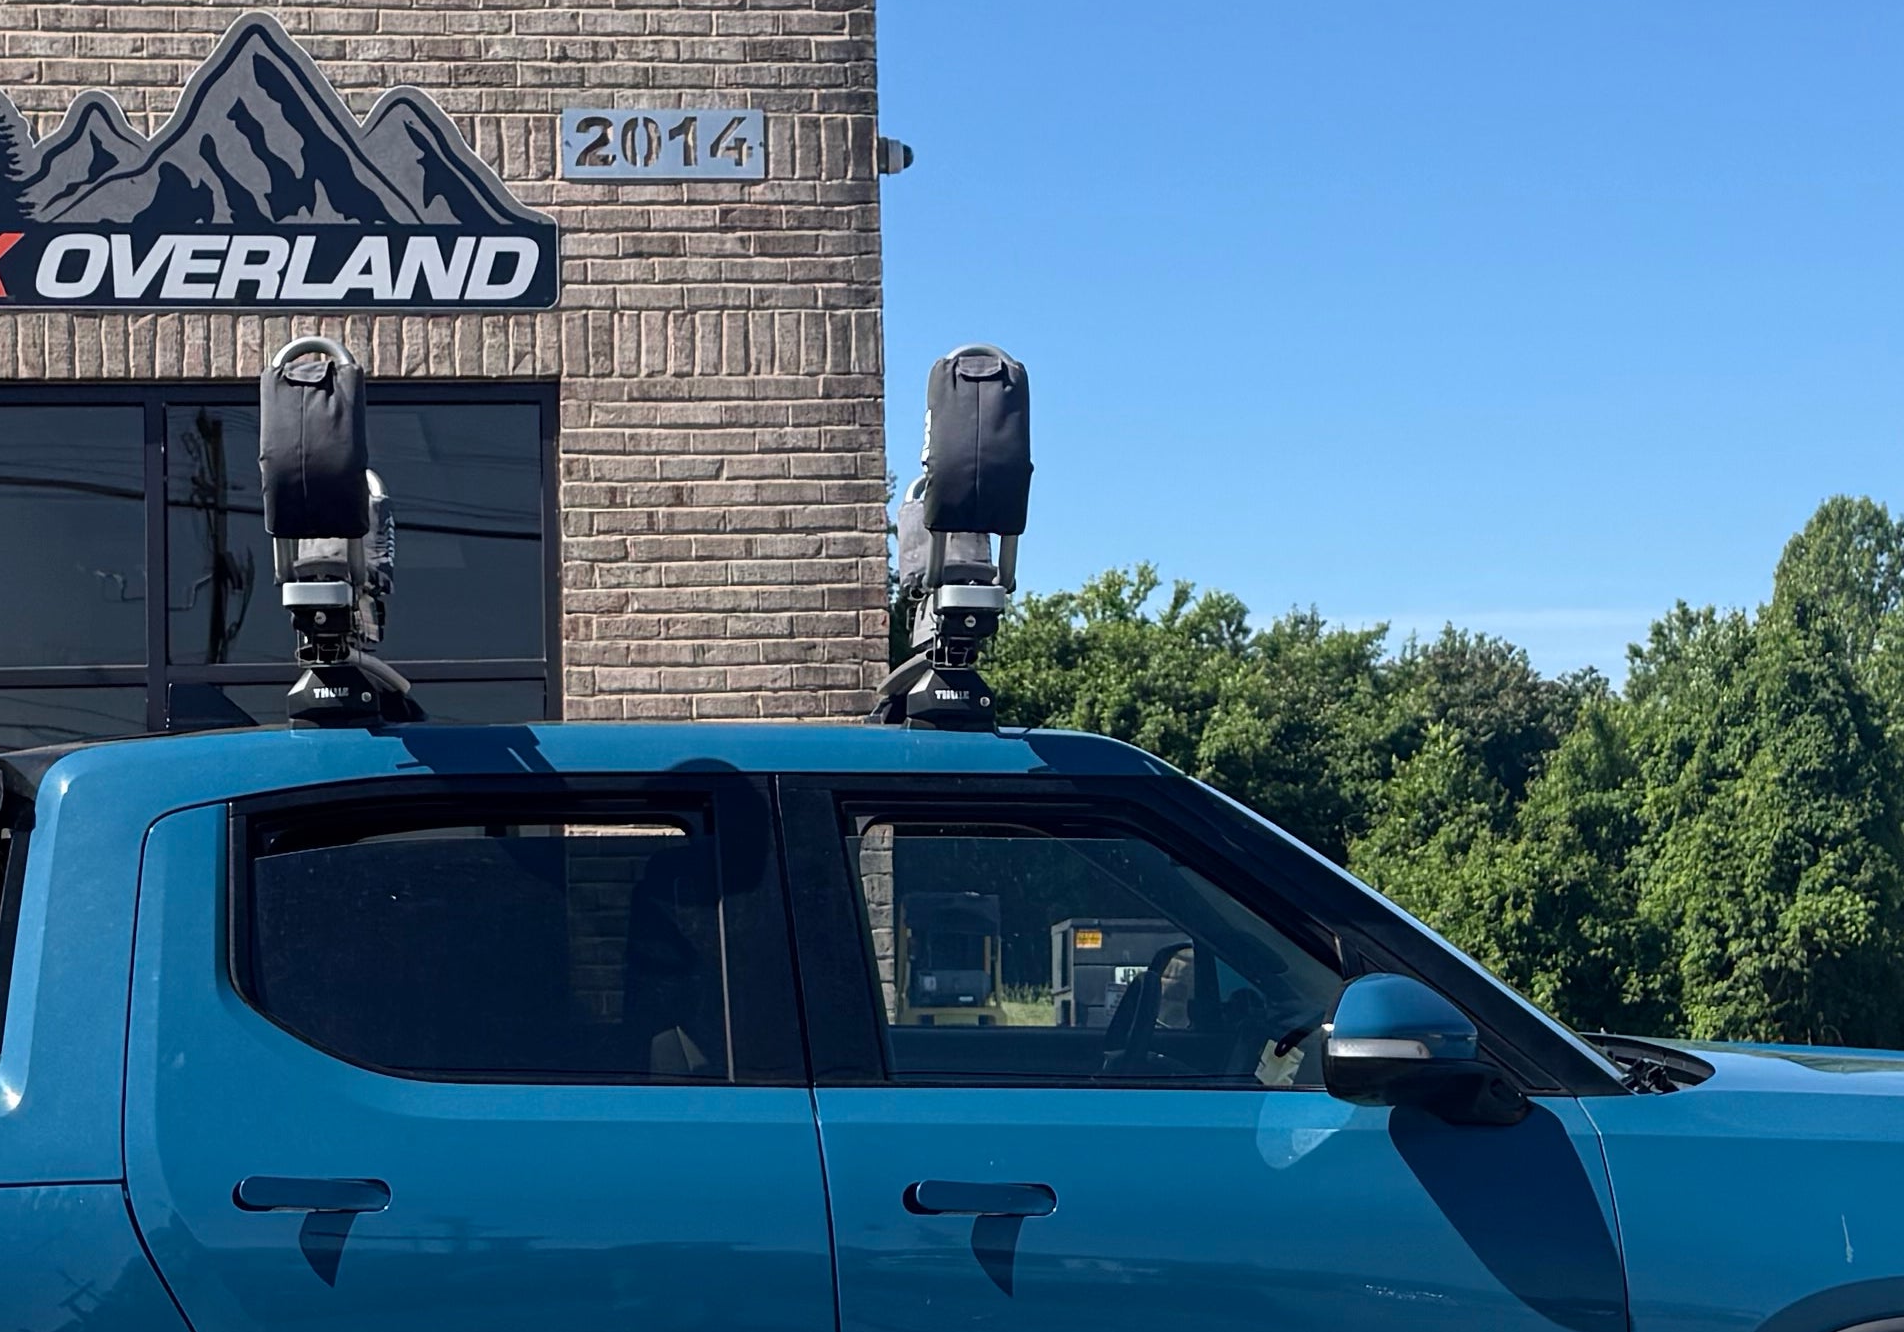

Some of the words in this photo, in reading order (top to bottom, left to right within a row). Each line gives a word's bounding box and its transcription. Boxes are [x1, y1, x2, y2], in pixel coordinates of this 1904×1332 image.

[575, 116, 753, 168] 2014
[34, 233, 541, 300] OVERLAND
[312, 687, 349, 699] THULE
[934, 690, 970, 700] THULE
